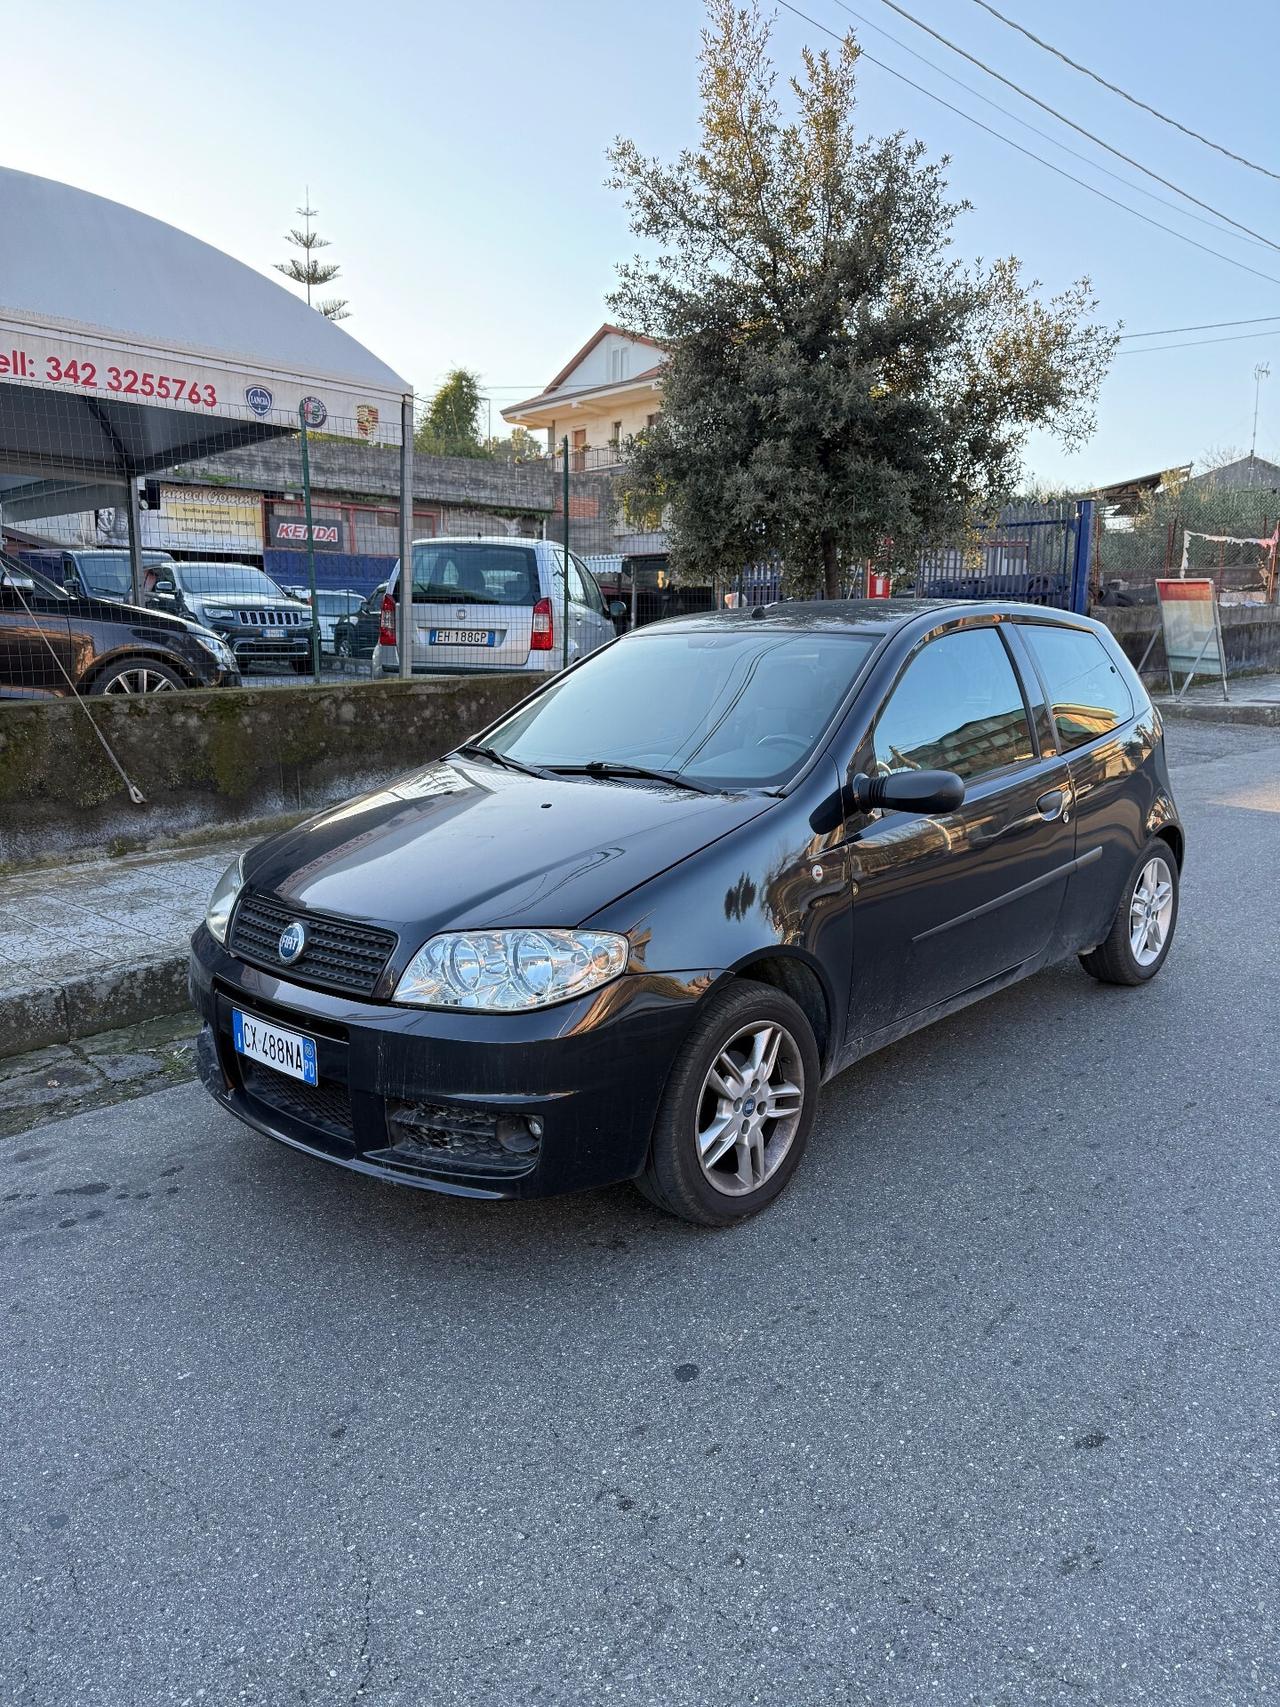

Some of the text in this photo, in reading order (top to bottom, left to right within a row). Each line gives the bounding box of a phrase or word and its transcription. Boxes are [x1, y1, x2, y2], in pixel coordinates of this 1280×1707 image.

[46, 356, 97, 387] 342
[107, 367, 217, 407] 3255763
[437, 631, 450, 642] EH
[455, 631, 487, 643] 188GP
[244, 1022, 257, 1052] CX
[262, 1032, 303, 1072] 488NA
[304, 1059, 315, 1078] PD
